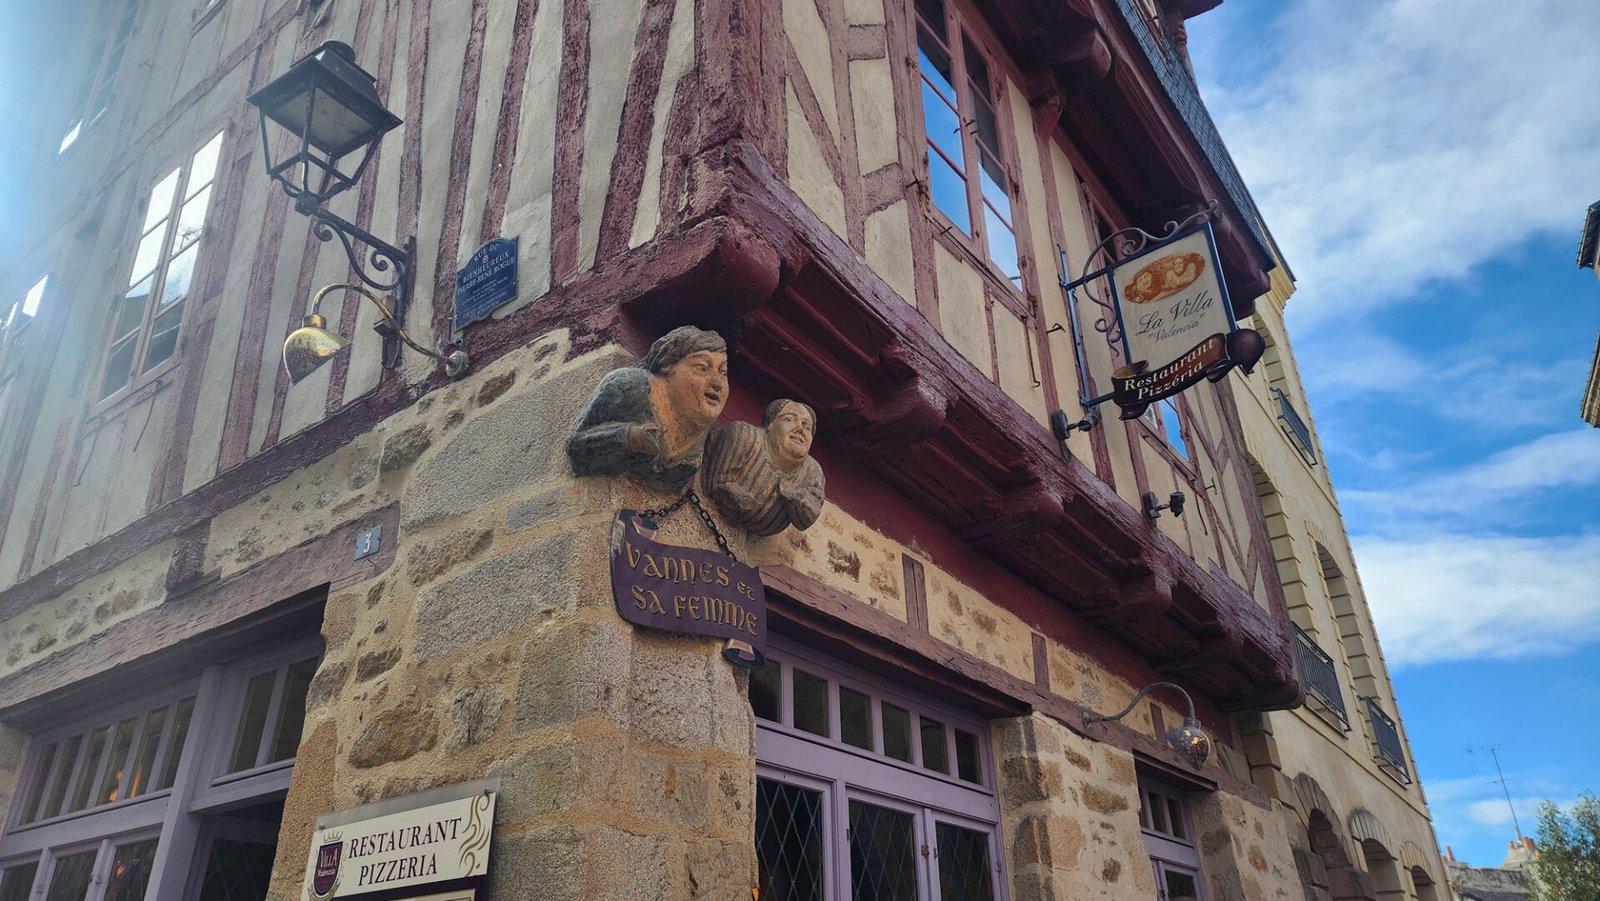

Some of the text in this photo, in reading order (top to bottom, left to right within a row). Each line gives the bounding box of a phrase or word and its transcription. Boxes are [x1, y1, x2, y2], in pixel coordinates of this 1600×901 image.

[1135, 290, 1214, 337] La Villa
[1124, 339, 1215, 392] Restaurant
[1137, 362, 1204, 400] Pizzéria
[363, 532, 372, 553] 3
[625, 541, 730, 587] VANNES
[632, 584, 759, 637] SA FEMME
[348, 817, 462, 859] RESTAURANT
[358, 852, 438, 886] PIZZERIA
